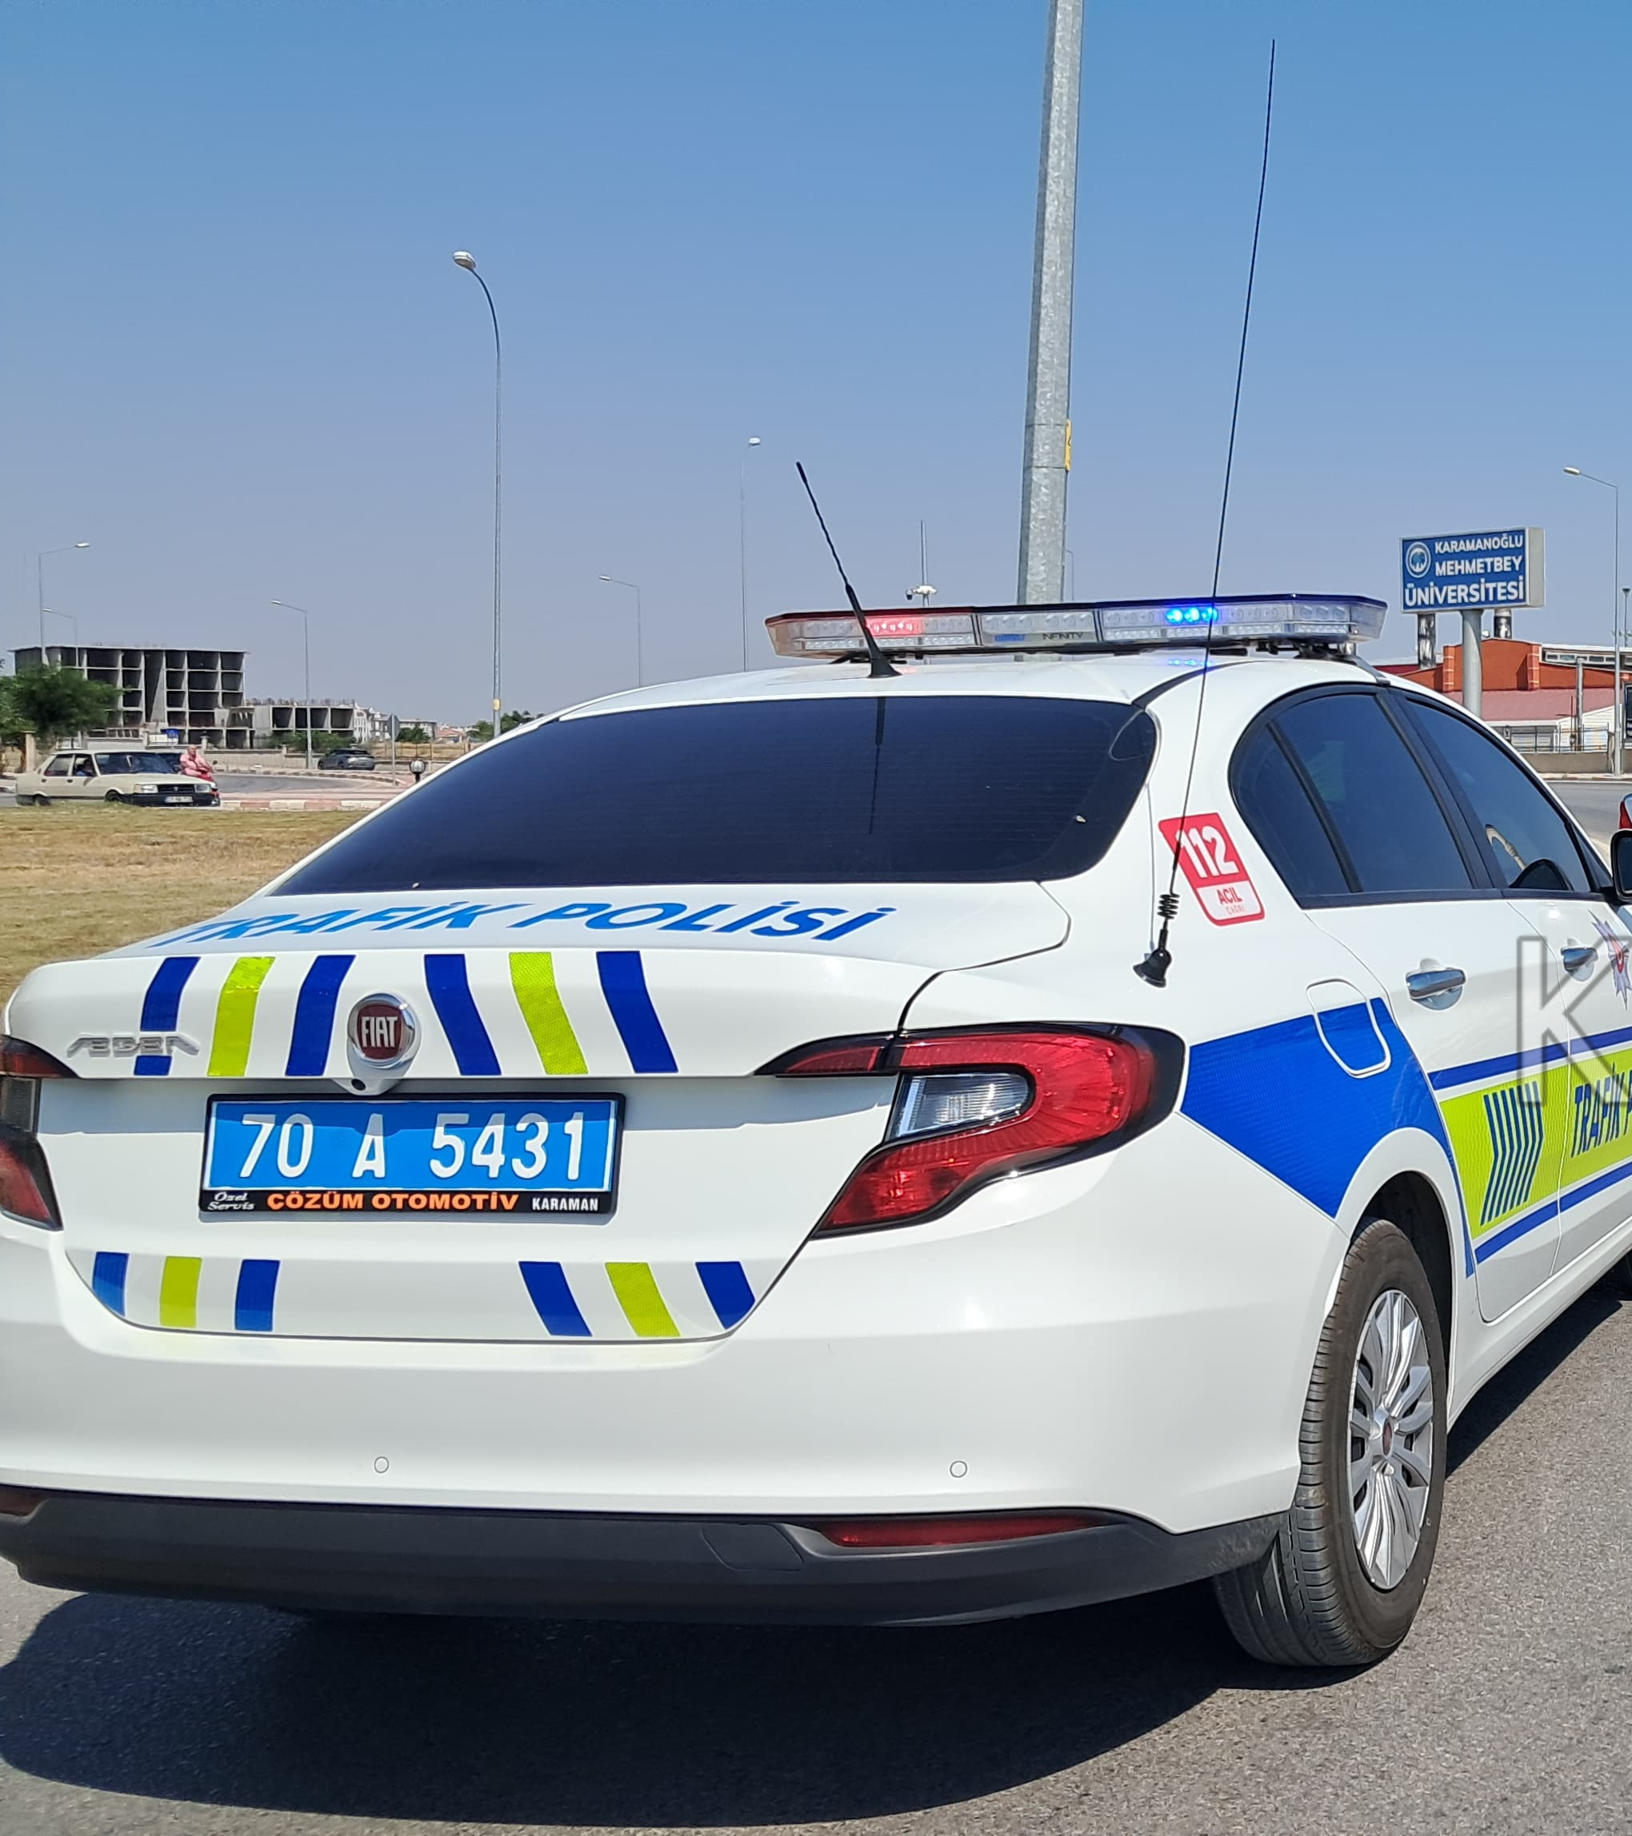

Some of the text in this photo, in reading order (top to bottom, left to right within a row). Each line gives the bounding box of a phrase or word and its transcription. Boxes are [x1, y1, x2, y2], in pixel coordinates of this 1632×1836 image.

[1434, 532, 1524, 554] KARAMANOĞLU
[1434, 555, 1523, 577] MEHMETBEY
[1404, 575, 1524, 606] ÜNİVERSİTESİ
[1174, 825, 1240, 879] 112
[144, 900, 898, 949] TRAFİK POLİSİ
[361, 1016, 399, 1048] FIAT
[1570, 1061, 1625, 1158] TRAFİK
[239, 1112, 584, 1180] 70 A 5431
[372, 1191, 519, 1211] OTOMOTİV
[532, 1197, 599, 1211] KARAMAN
